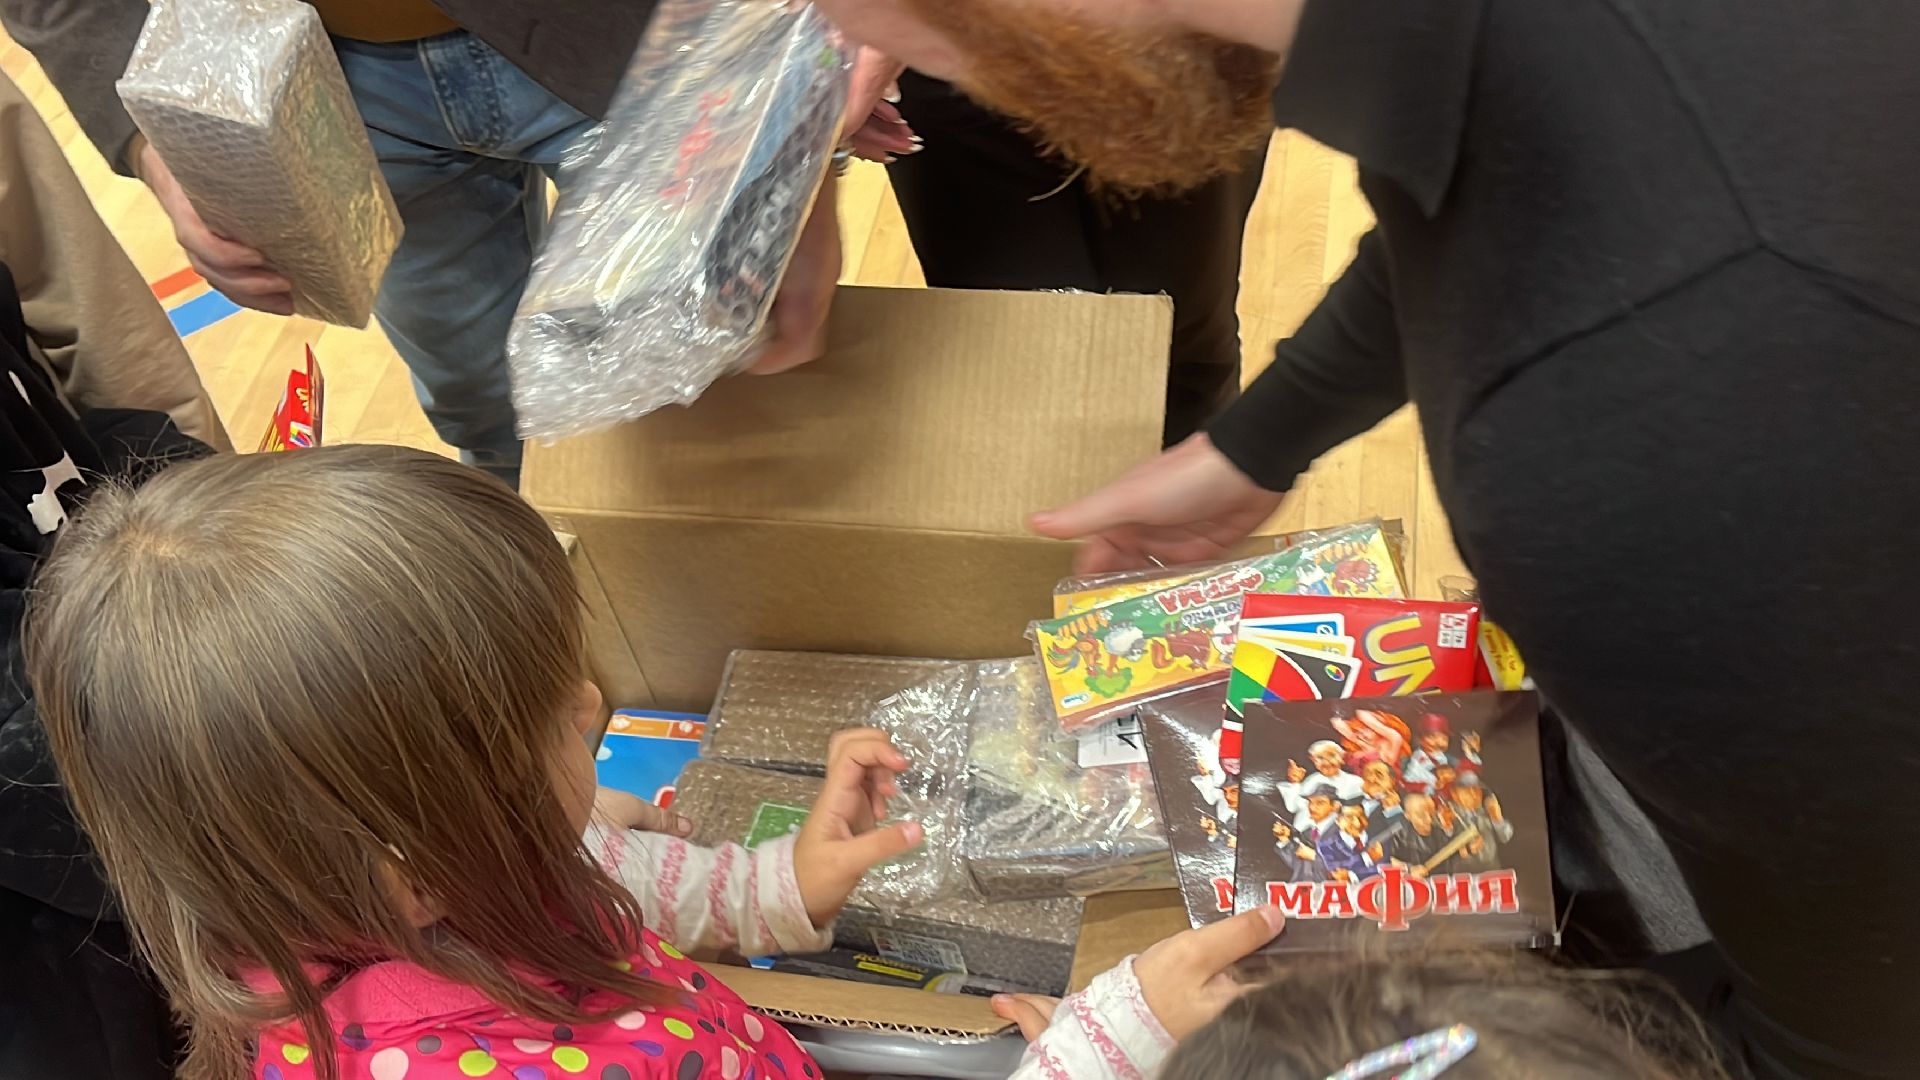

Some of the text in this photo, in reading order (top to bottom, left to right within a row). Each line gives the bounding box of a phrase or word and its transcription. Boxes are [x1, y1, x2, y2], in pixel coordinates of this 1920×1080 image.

[1155, 569, 1263, 615] ФЕРМА
[1182, 600, 1240, 624] ОМИНО
[1362, 614, 1441, 697] UN
[1266, 864, 1519, 930] МАФИЯ
